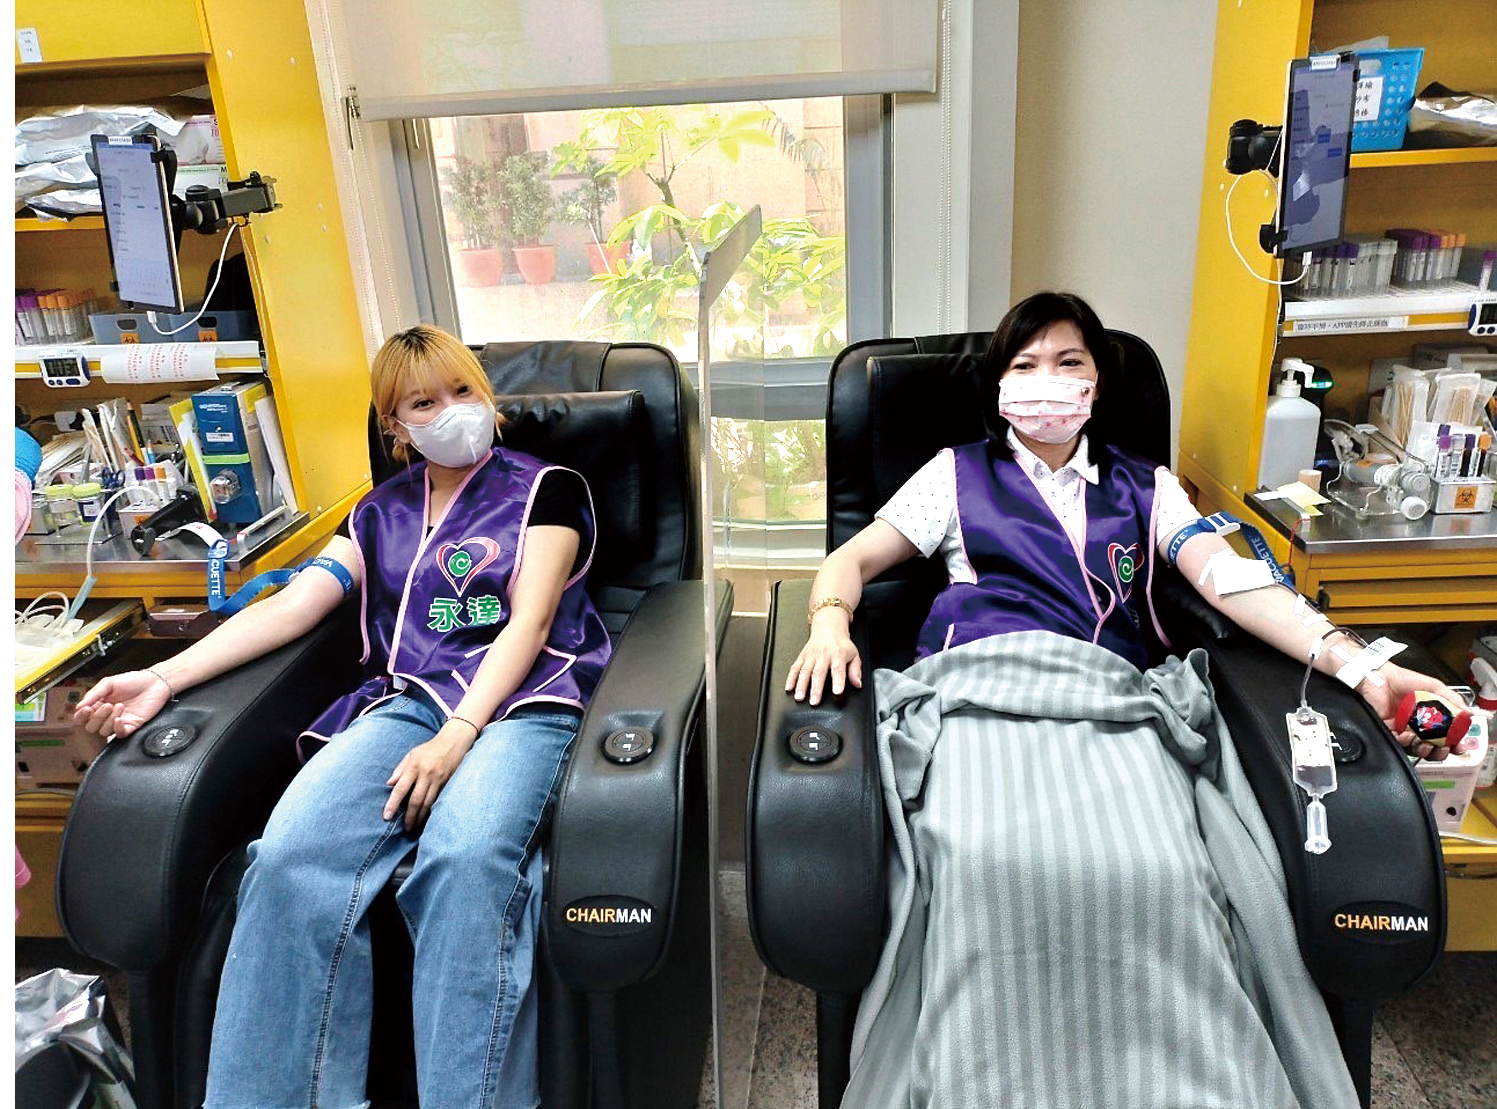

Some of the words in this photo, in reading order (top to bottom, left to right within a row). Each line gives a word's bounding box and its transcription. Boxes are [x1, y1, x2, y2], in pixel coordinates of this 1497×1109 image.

[426, 594, 502, 633] 永達
[566, 907, 652, 923] CHAIRMAN
[1334, 913, 1429, 931] CHAIRMAN
